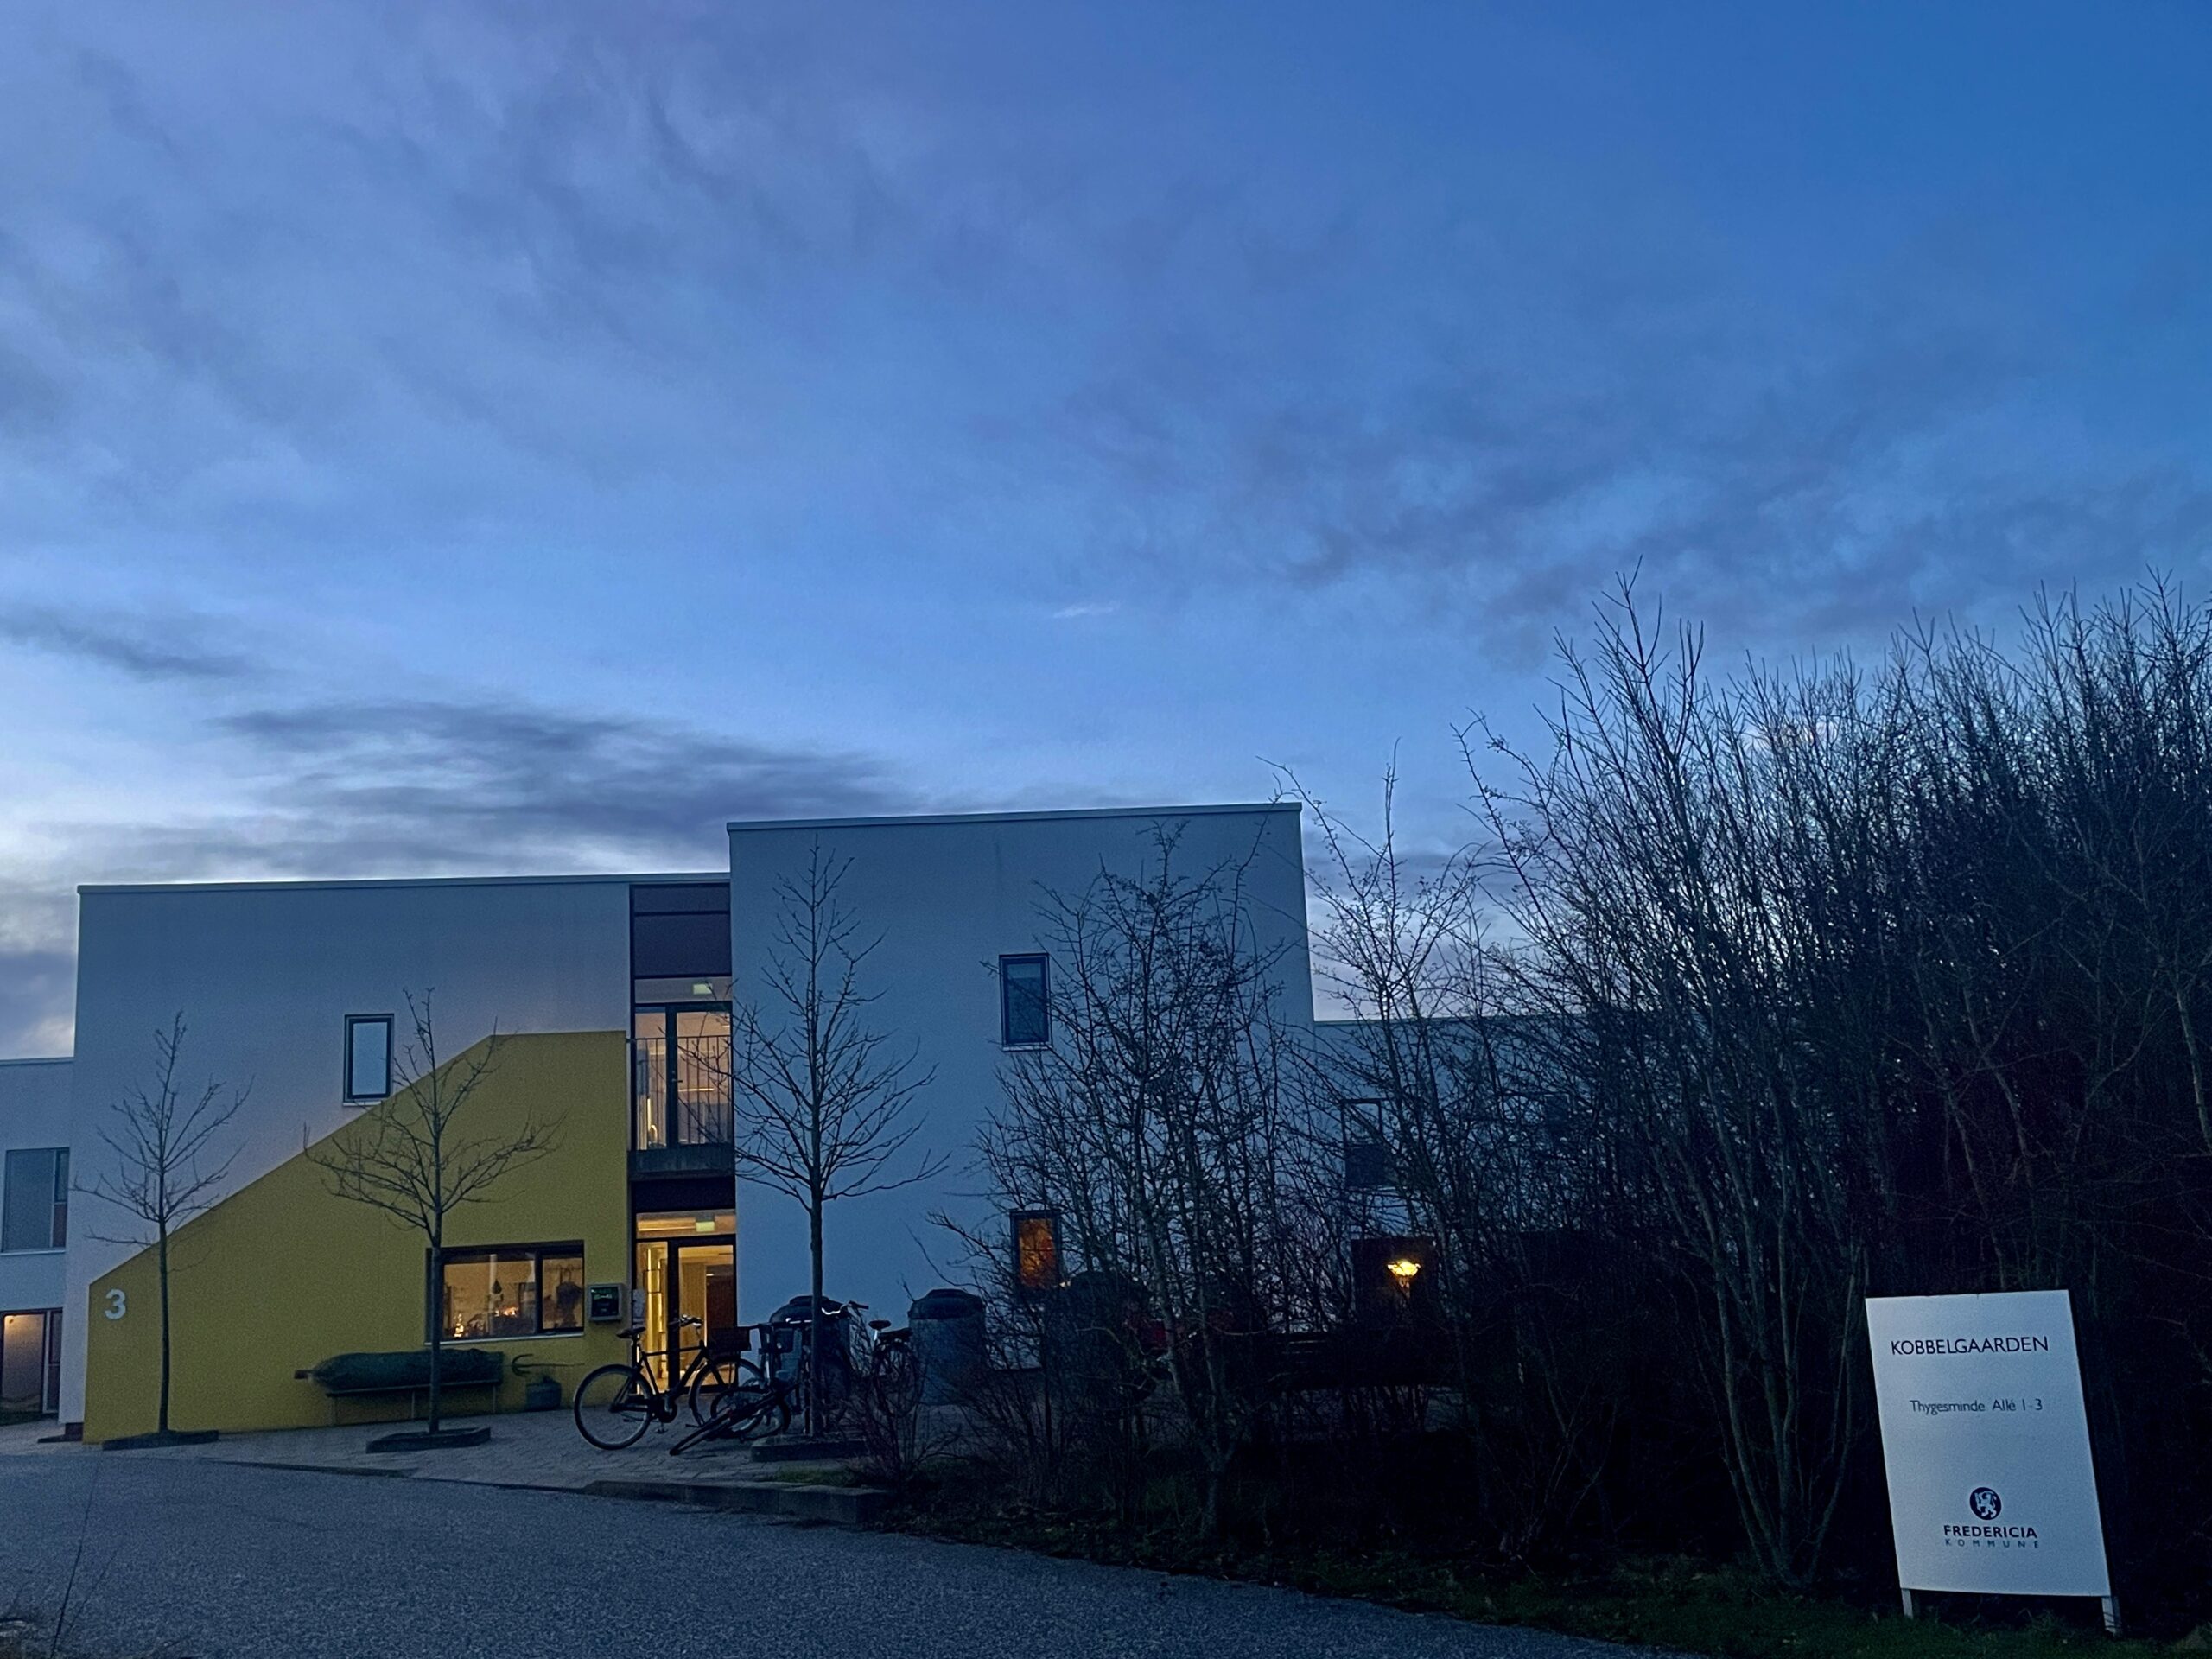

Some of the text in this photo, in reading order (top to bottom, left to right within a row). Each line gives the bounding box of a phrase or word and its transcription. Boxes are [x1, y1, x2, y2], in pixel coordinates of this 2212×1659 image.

[105, 1288, 126, 1319] 3
[1891, 1336, 2049, 1355] KOBBELGAARDEN
[1910, 1399, 1986, 1415] Thygesminde
[1992, 1398, 2017, 1411] Allé
[1943, 1525, 2037, 1538] FREDERICIA
[1945, 1538, 2038, 1548] KOMMUNE
